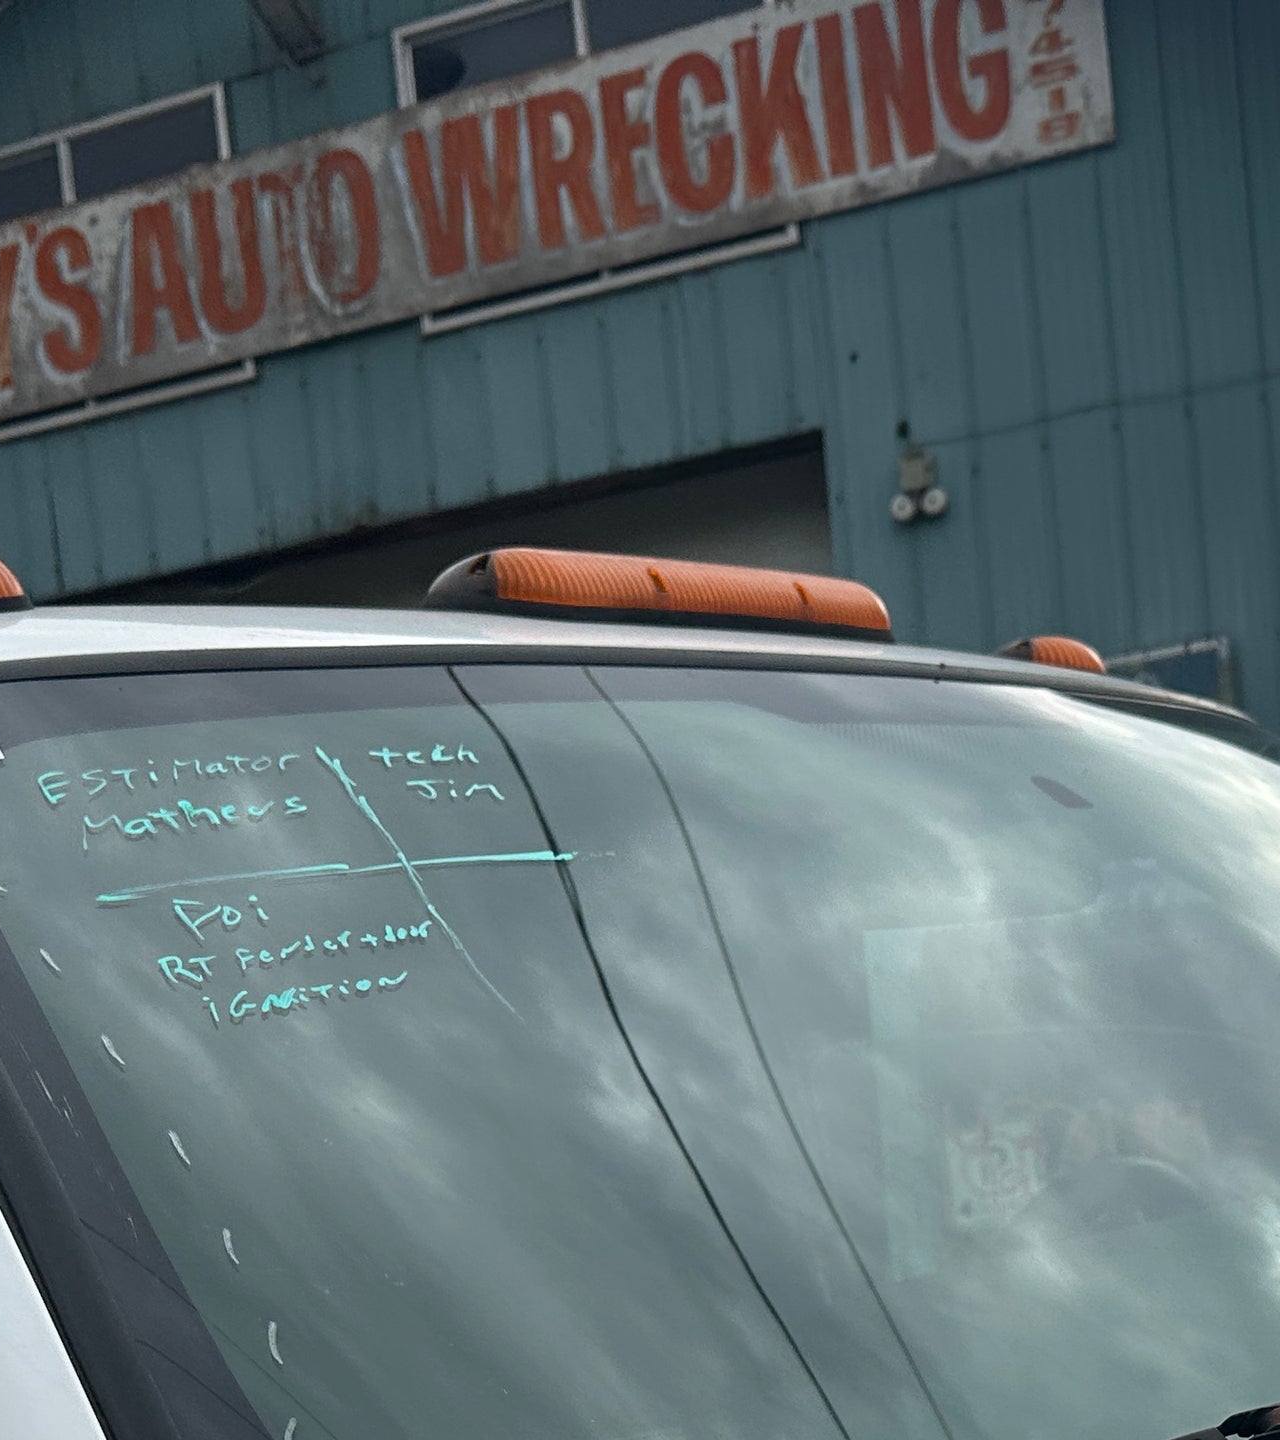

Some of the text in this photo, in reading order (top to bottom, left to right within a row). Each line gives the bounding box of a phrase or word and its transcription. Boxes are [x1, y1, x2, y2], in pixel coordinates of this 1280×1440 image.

[130, 148, 380, 356] AUTO
[404, 0, 1010, 279] WRECKING
[157, 954, 216, 984] RT
